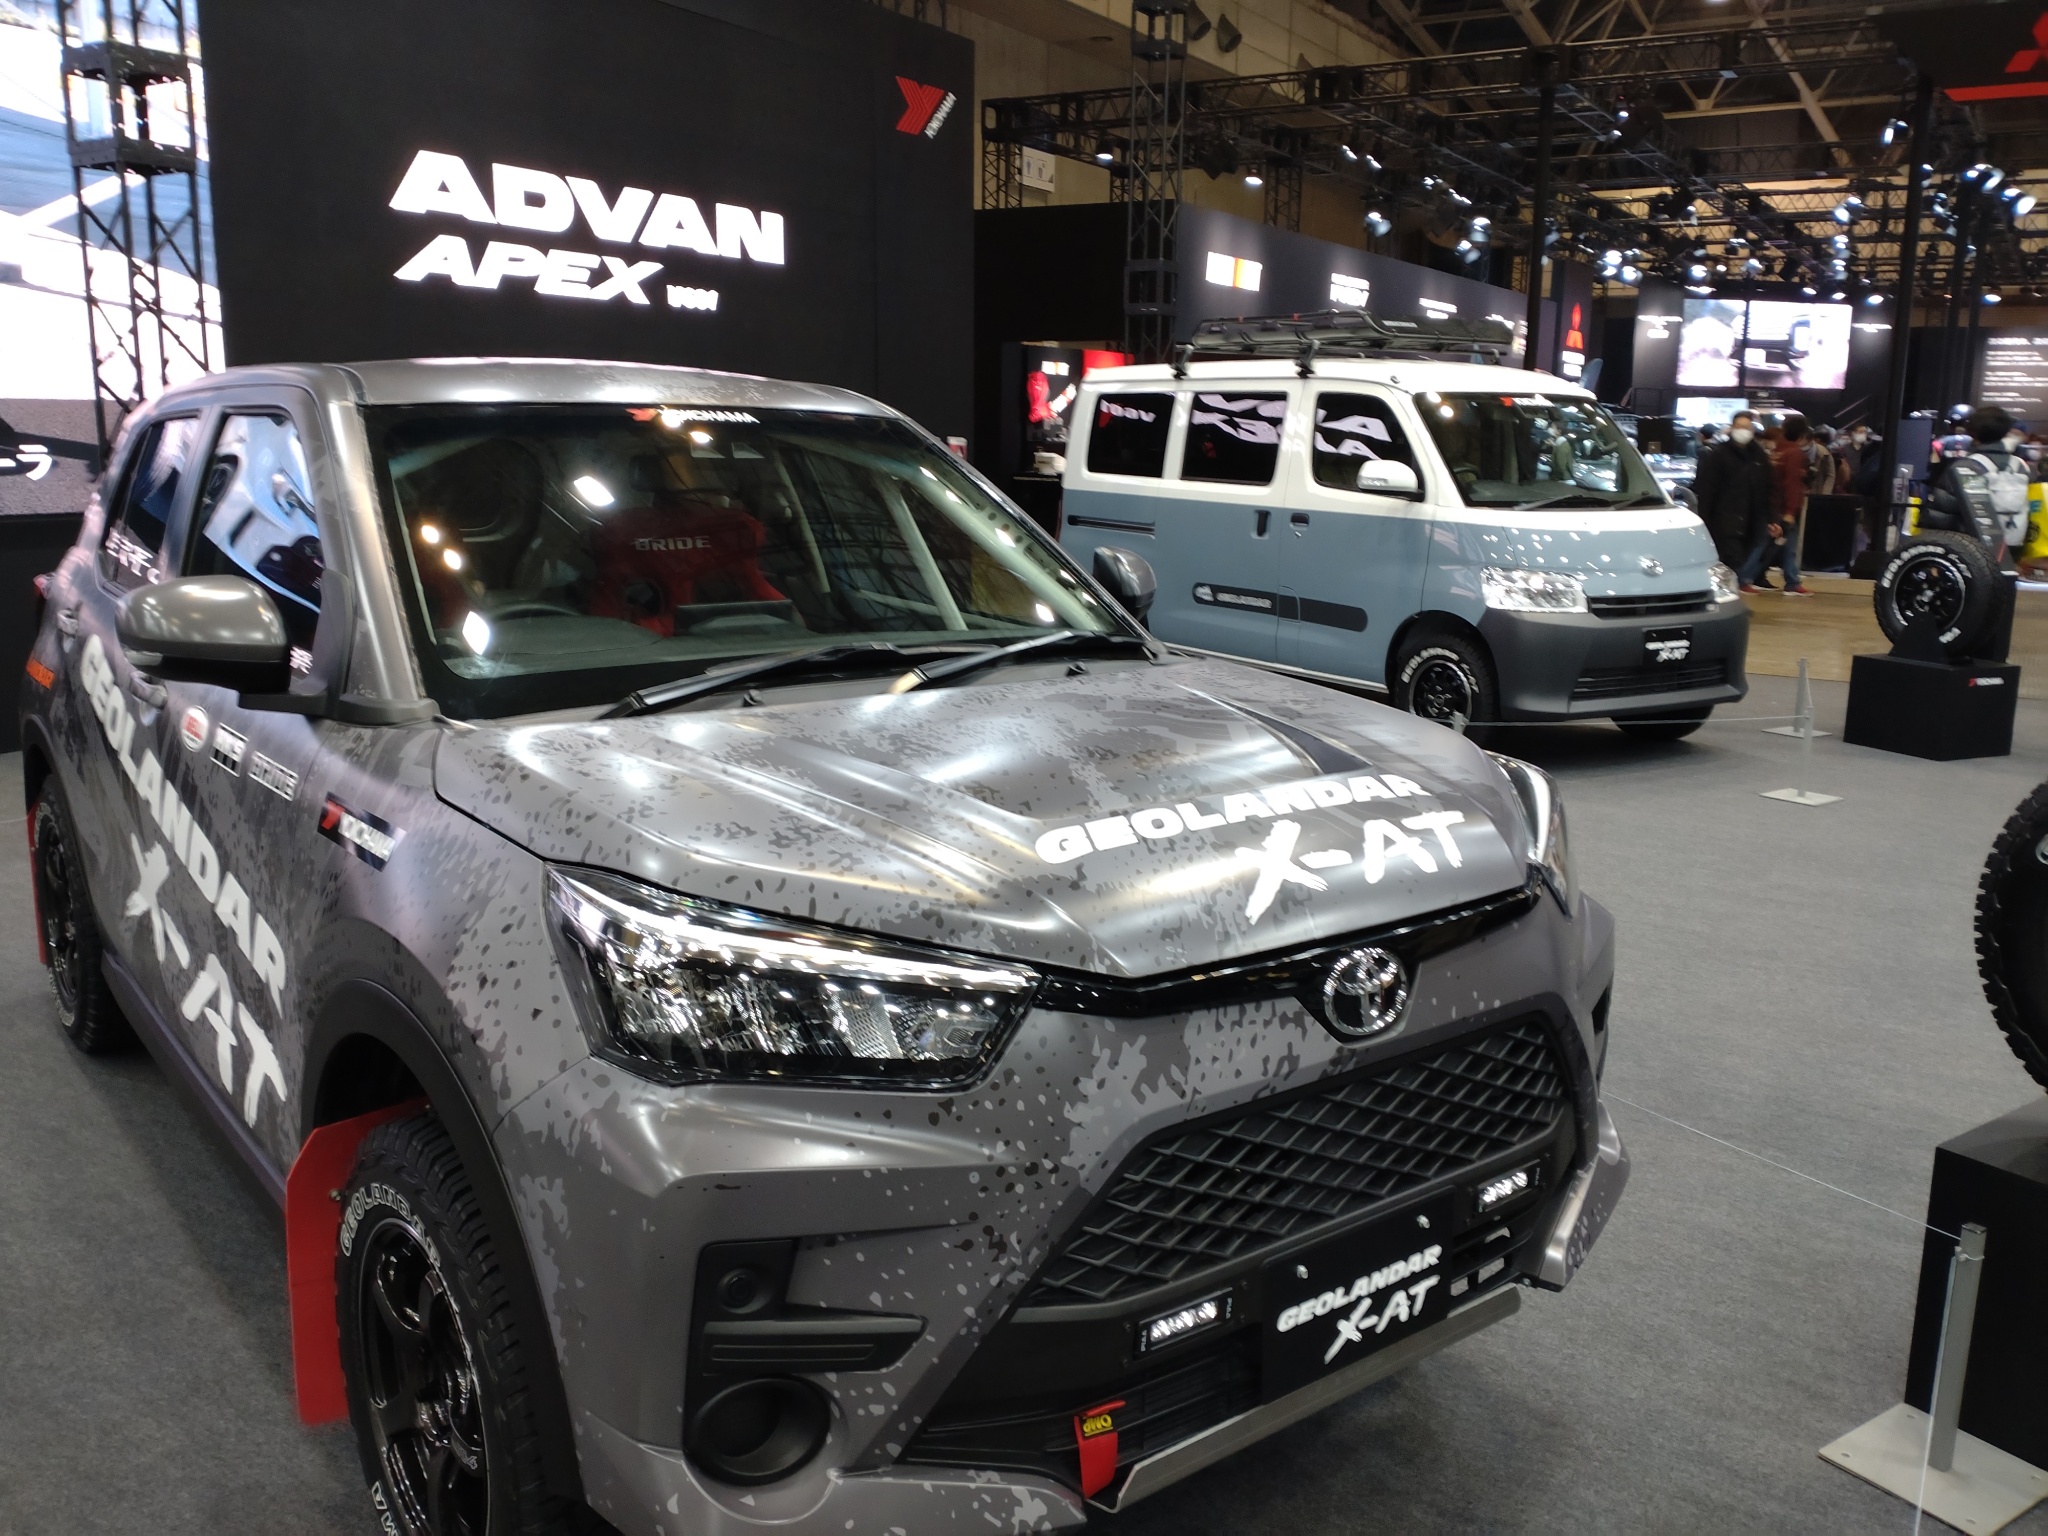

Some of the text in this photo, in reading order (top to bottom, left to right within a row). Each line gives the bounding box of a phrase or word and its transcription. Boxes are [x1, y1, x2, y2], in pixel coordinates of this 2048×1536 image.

[388, 149, 785, 265] ADVAN
[393, 234, 664, 305] APEX
[656, 405, 760, 428] YKOHAMA
[631, 536, 712, 551] BRIDE
[80, 634, 285, 1019] GEOLANDAR
[1035, 774, 1432, 864] GEOLANDAR
[1235, 811, 1465, 926] X-AT
[125, 832, 286, 1128] X-AT
[1276, 1244, 1443, 1333] GEOLANDAR
[1324, 1274, 1441, 1365] X-AT
[1082, 1414, 1112, 1433] OMP
